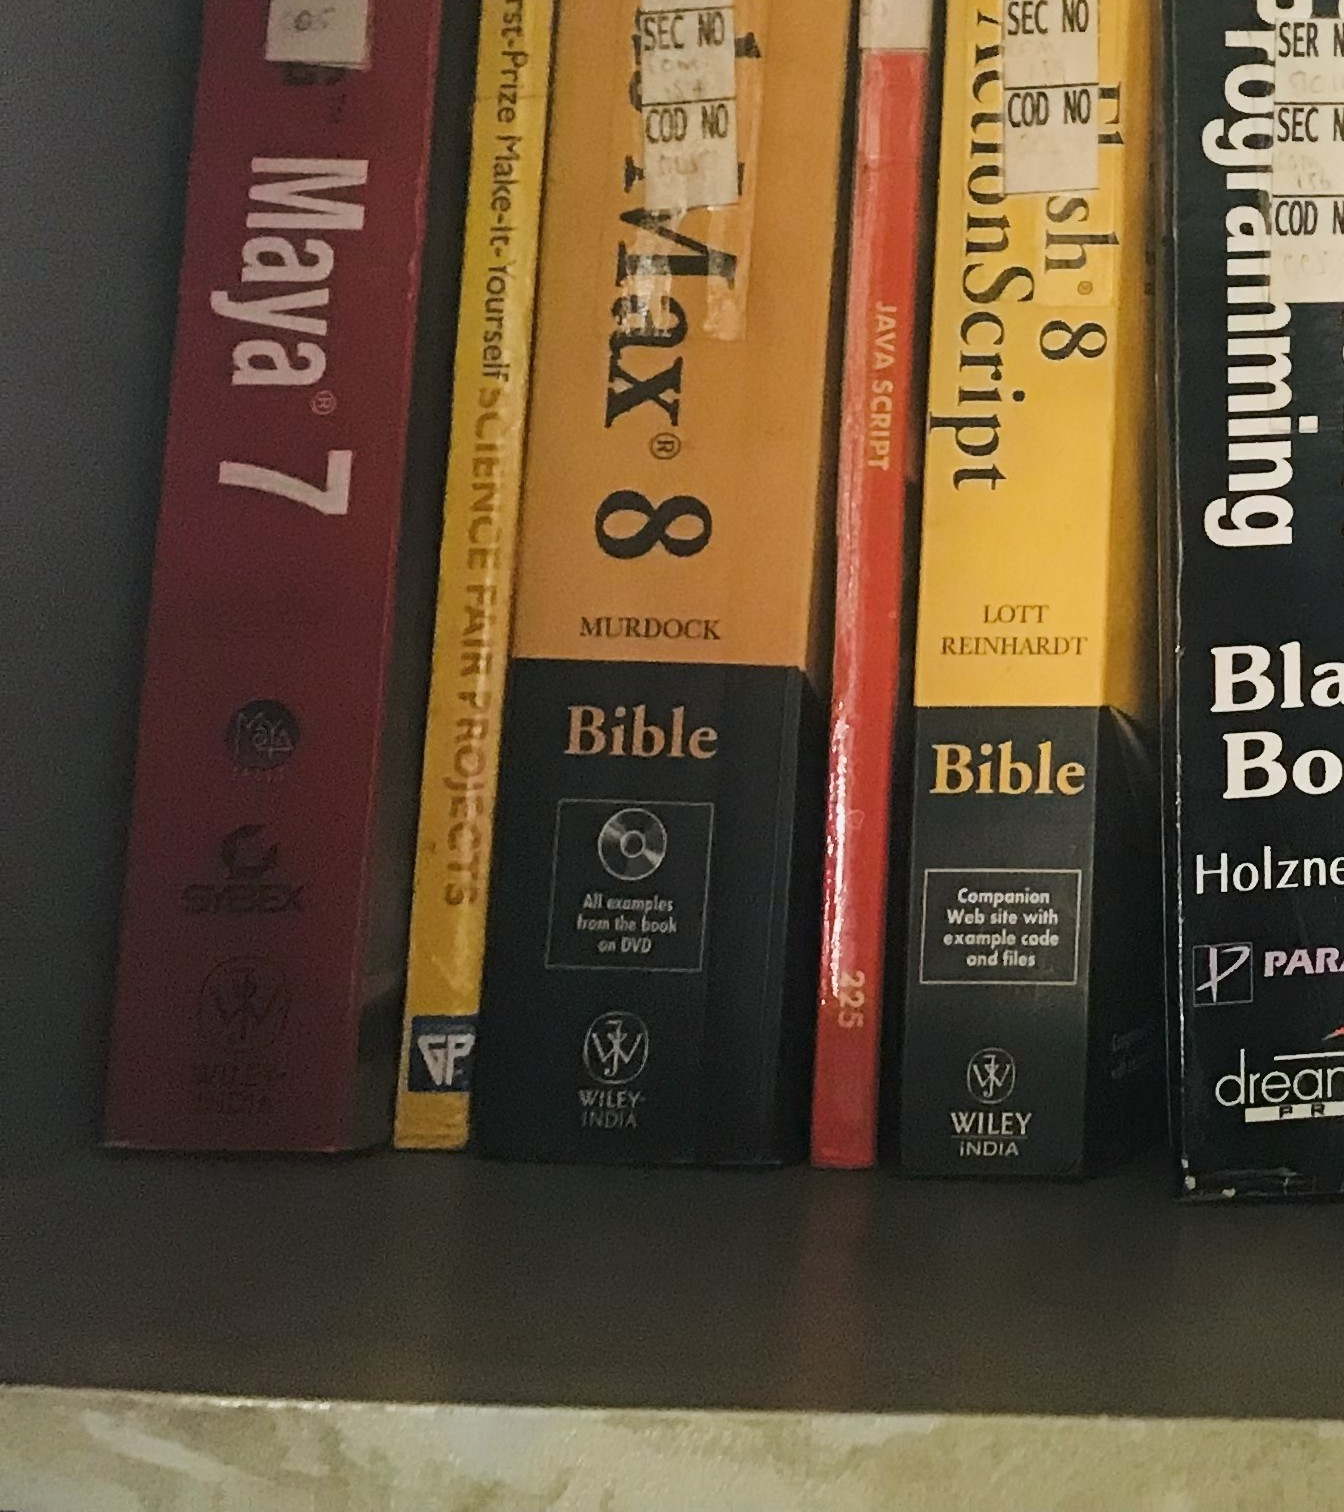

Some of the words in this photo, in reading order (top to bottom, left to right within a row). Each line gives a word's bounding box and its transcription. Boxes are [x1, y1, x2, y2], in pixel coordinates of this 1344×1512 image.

[211, 157, 370, 387] Maya
[872, 300, 898, 370] JAVA
[1039, 320, 1108, 362] 8
[867, 377, 893, 471] SCRIPT
[219, 449, 352, 516] 7
[463, 384, 504, 565] SCIENCE
[595, 489, 712, 559] 8
[459, 574, 500, 679] FAIR
[580, 616, 721, 640] MURDOCK
[982, 604, 1049, 624] LOTT
[941, 636, 1086, 657] REINHARDT
[565, 706, 719, 759] Bible
[930, 742, 1086, 796] Bible
[444, 694, 495, 907] PROJECTS
[946, 908, 980, 926] Web
[990, 908, 1016, 926] site
[1025, 908, 1059, 926] with
[958, 888, 1050, 907] Companion
[944, 930, 1015, 949] example
[1021, 929, 1059, 947] code
[966, 950, 998, 967] and
[1002, 950, 1035, 967] files
[951, 1112, 1031, 1136] WILEY
